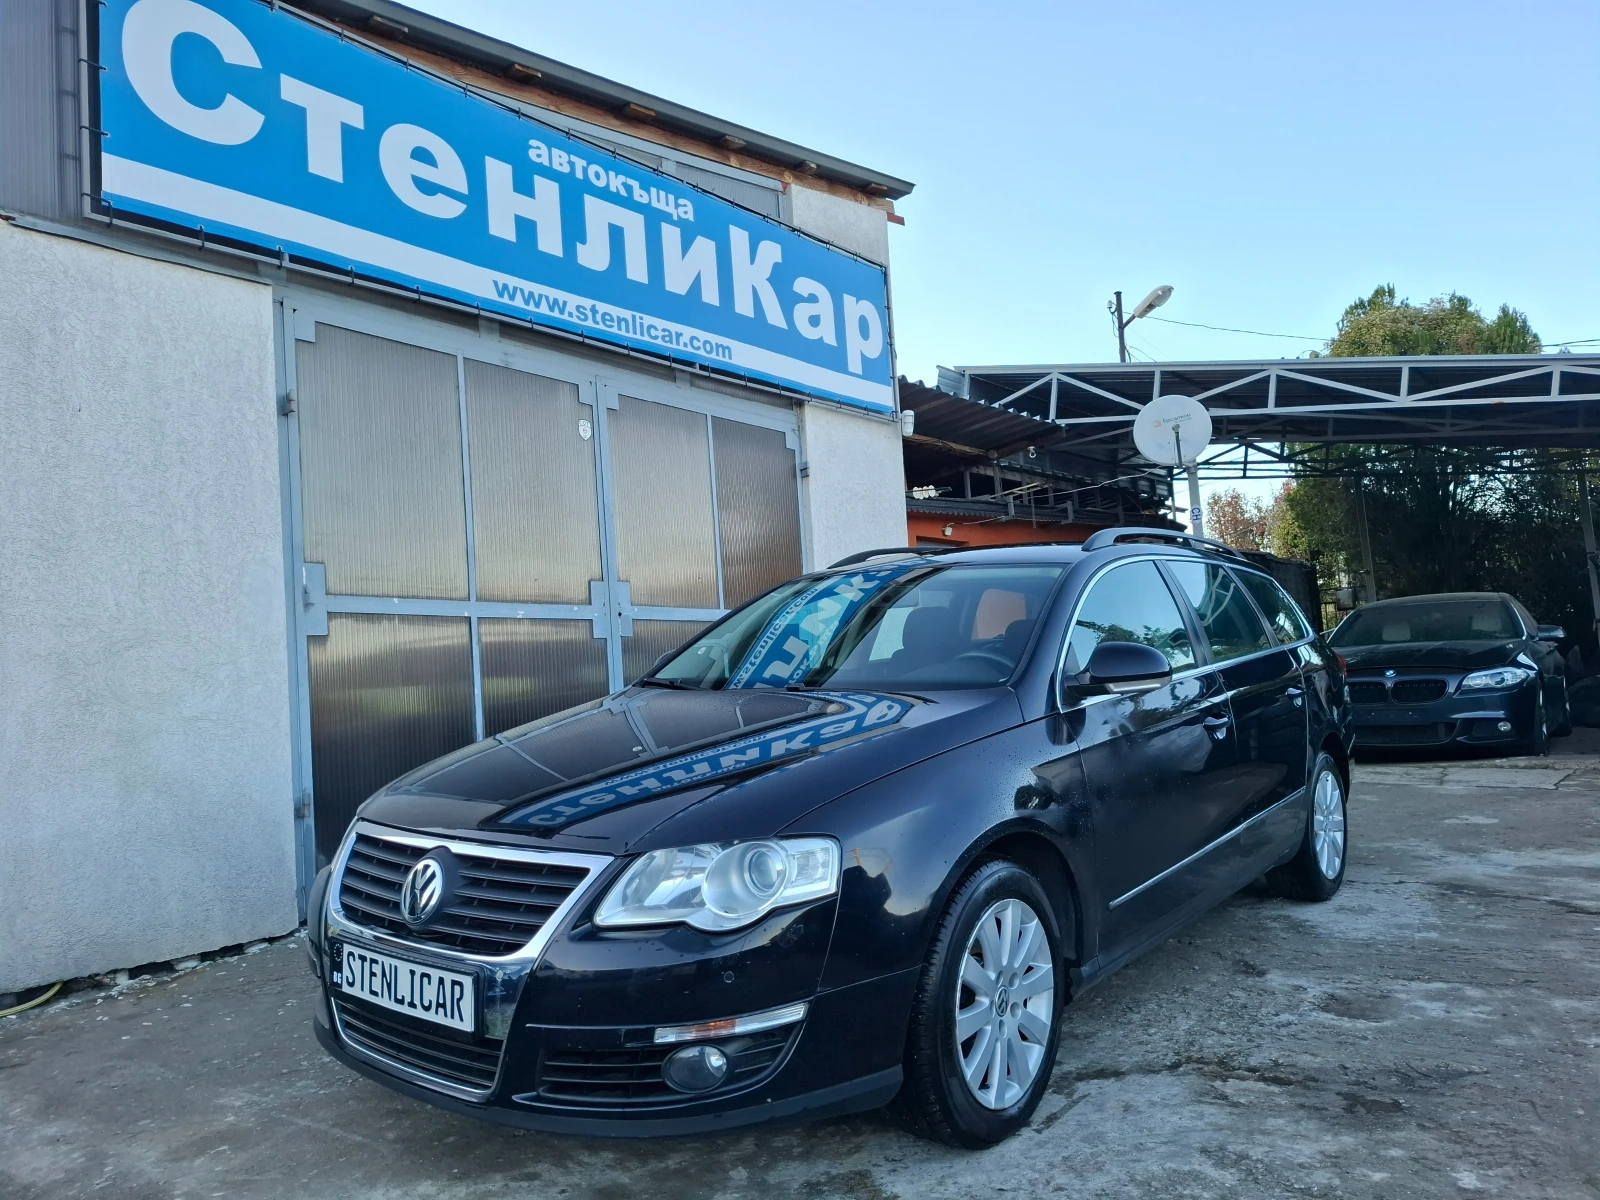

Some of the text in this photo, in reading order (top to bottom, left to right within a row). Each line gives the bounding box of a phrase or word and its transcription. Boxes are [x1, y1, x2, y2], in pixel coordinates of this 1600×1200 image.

[121, 0, 882, 375] СтенлиКар
[528, 138, 694, 222] автокъща
[493, 279, 733, 361] www.stenlicar.com
[1191, 507, 1202, 521] CH
[333, 971, 342, 984] BG
[345, 950, 465, 1022] STENLICAR
